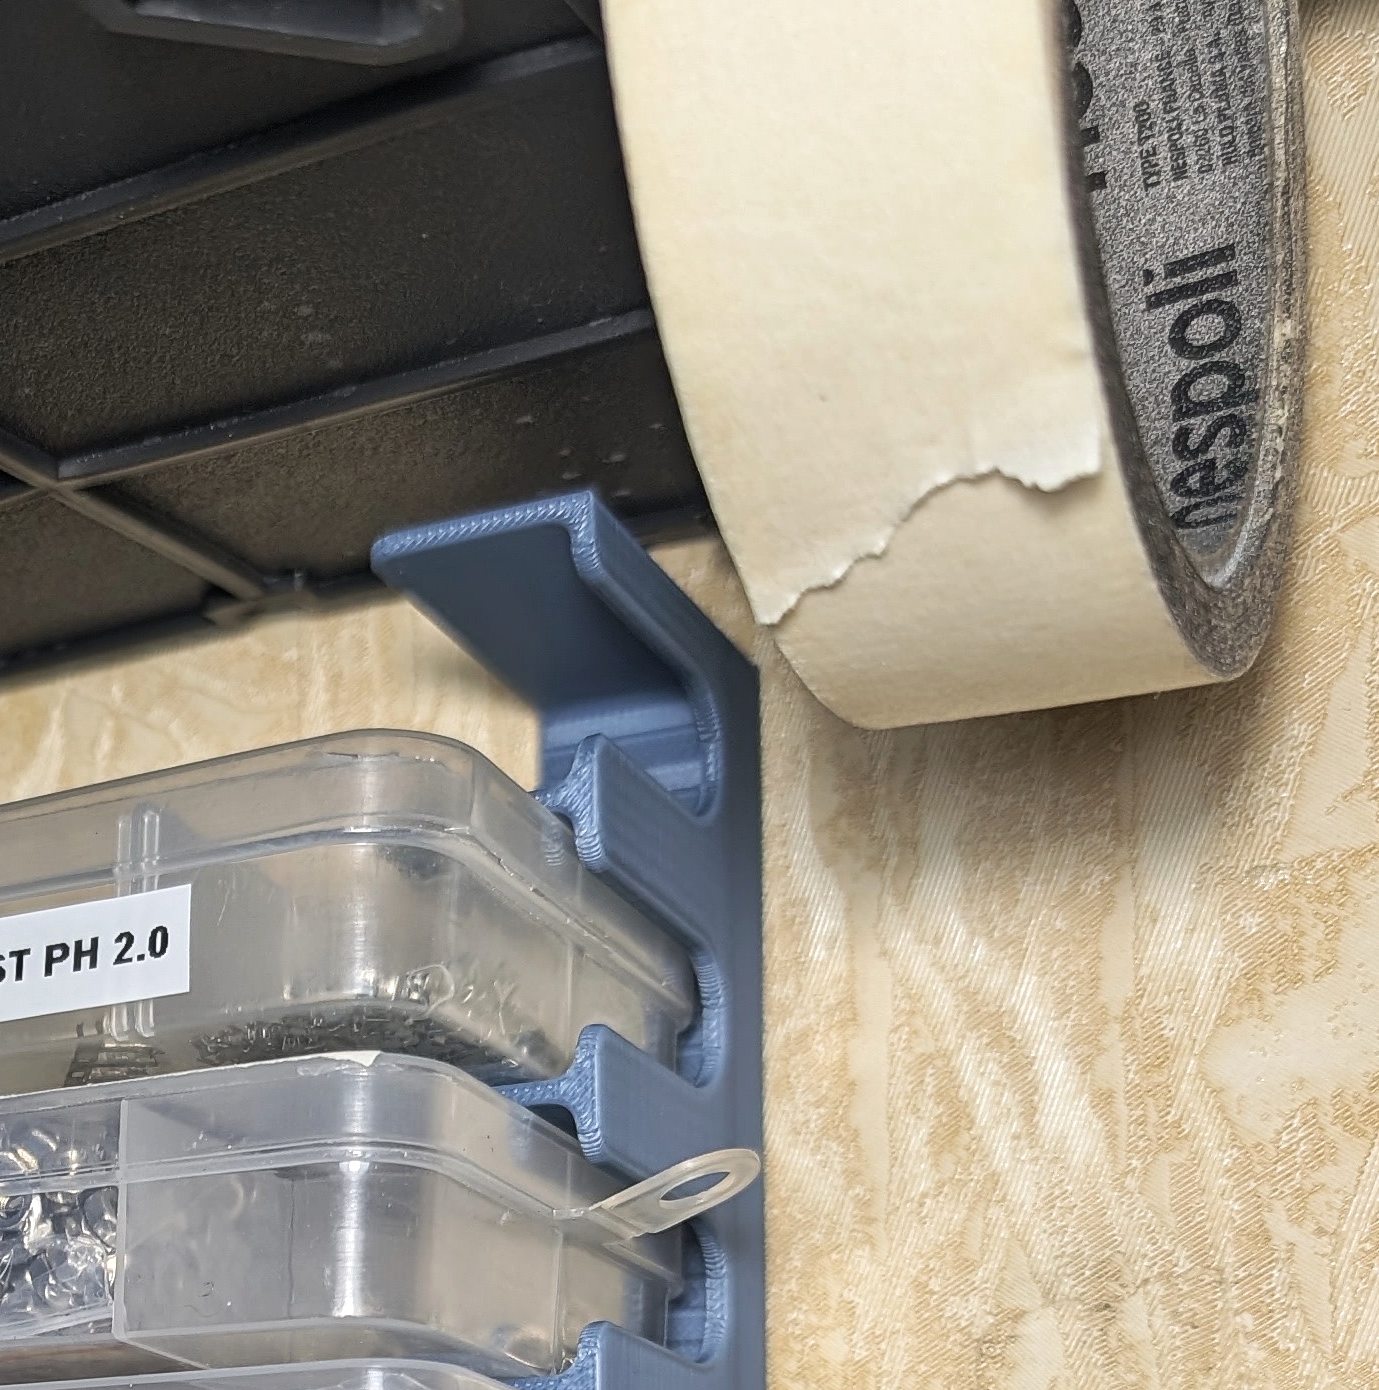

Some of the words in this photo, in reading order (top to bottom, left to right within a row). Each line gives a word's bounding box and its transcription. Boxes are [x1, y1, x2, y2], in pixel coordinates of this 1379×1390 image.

[1138, 147, 1162, 191] TYPE
[1163, 116, 1191, 181] NESPOLI
[1142, 244, 1259, 529] nespoli
[44, 936, 99, 977] PH
[113, 925, 169, 966] 2.0
